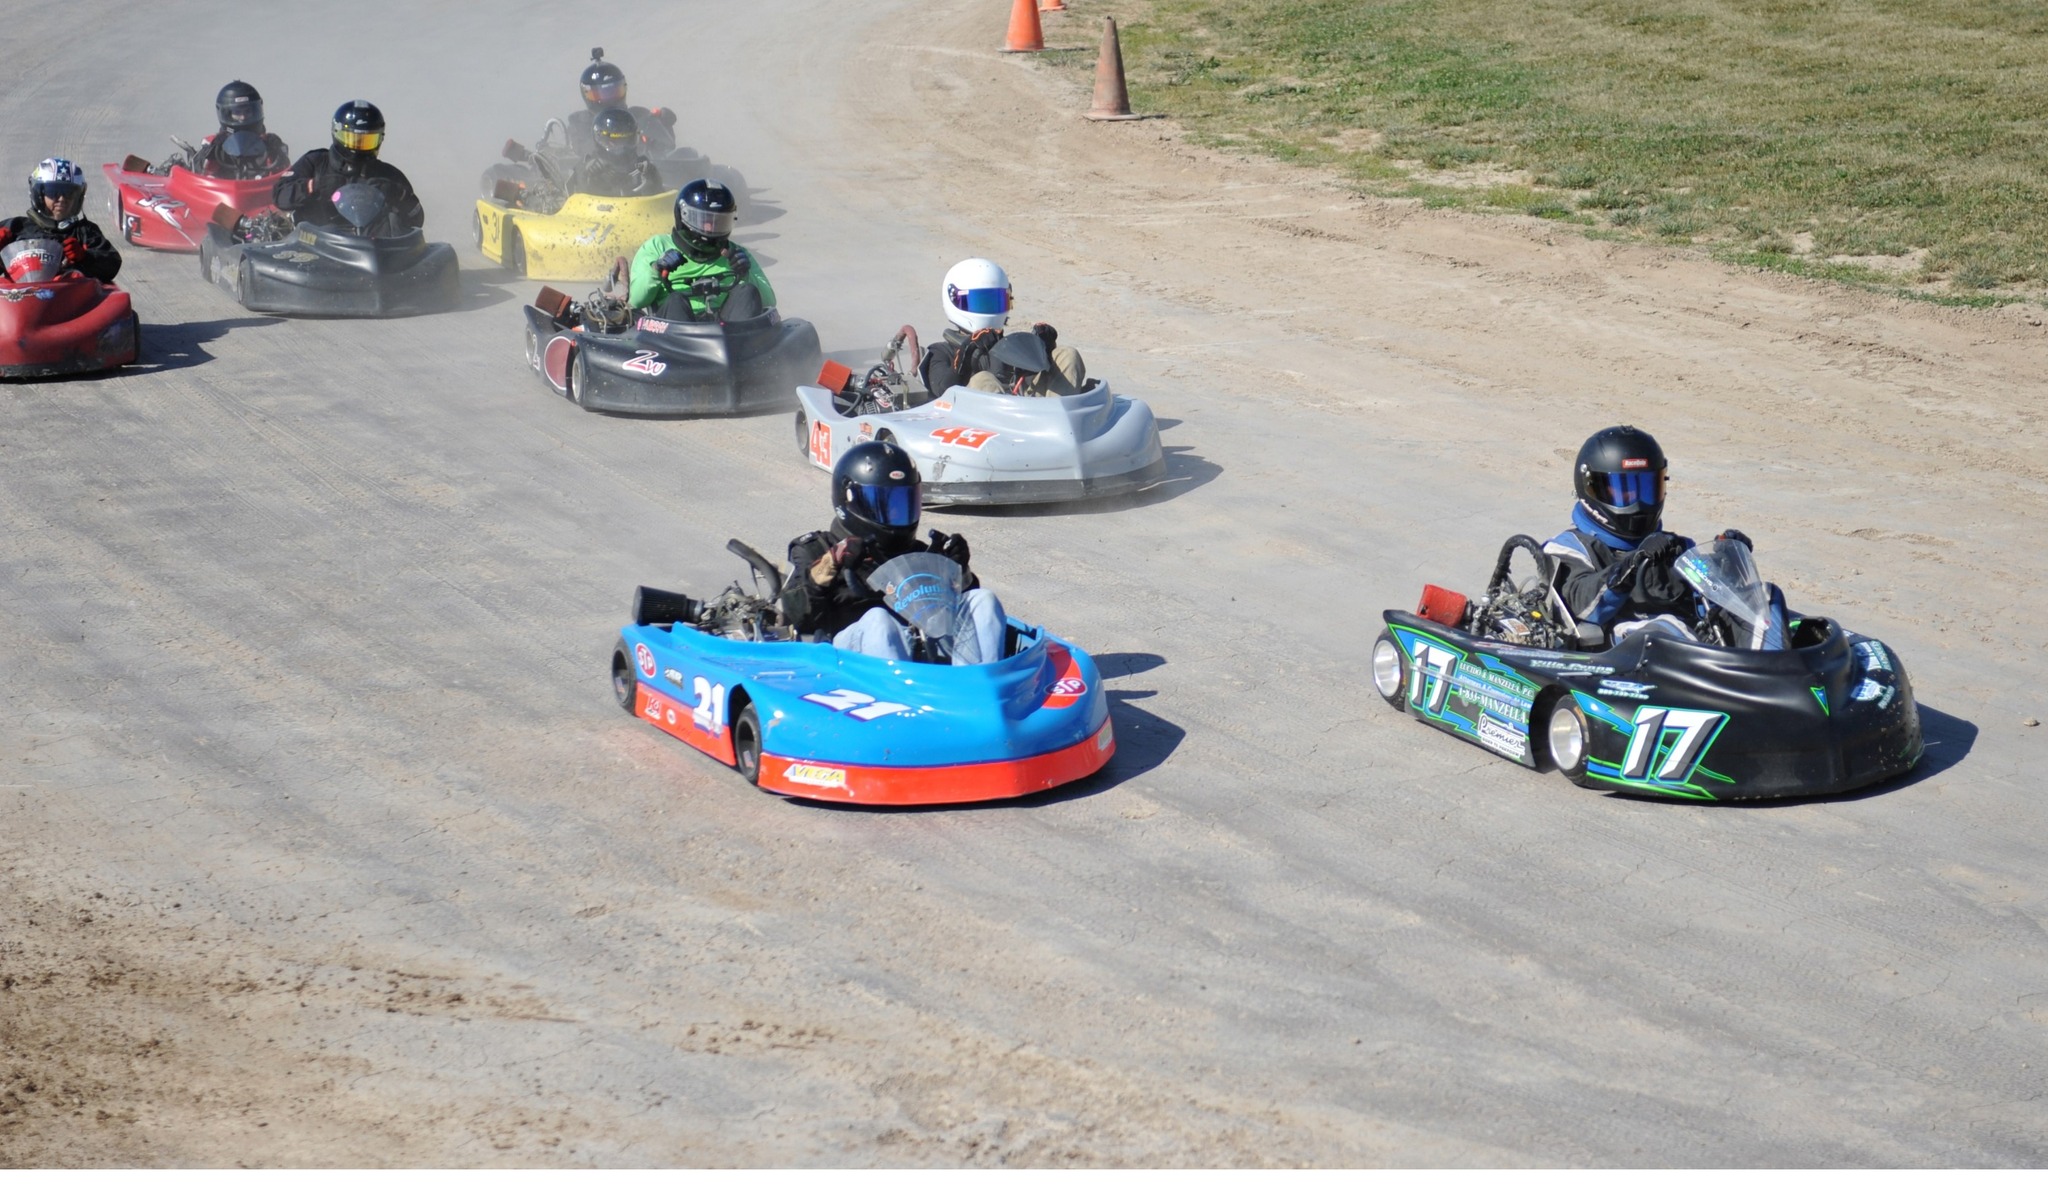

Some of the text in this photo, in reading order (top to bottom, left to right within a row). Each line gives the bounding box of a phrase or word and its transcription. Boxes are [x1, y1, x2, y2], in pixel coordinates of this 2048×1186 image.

[492, 212, 500, 244] 31
[810, 420, 832, 468] 43
[929, 426, 1000, 451] 43
[638, 647, 653, 670] STP
[1053, 680, 1081, 694] STP
[1411, 639, 1458, 717] 17
[693, 676, 725, 735] 21
[799, 689, 912, 721] 21
[1622, 706, 1728, 782] 17
